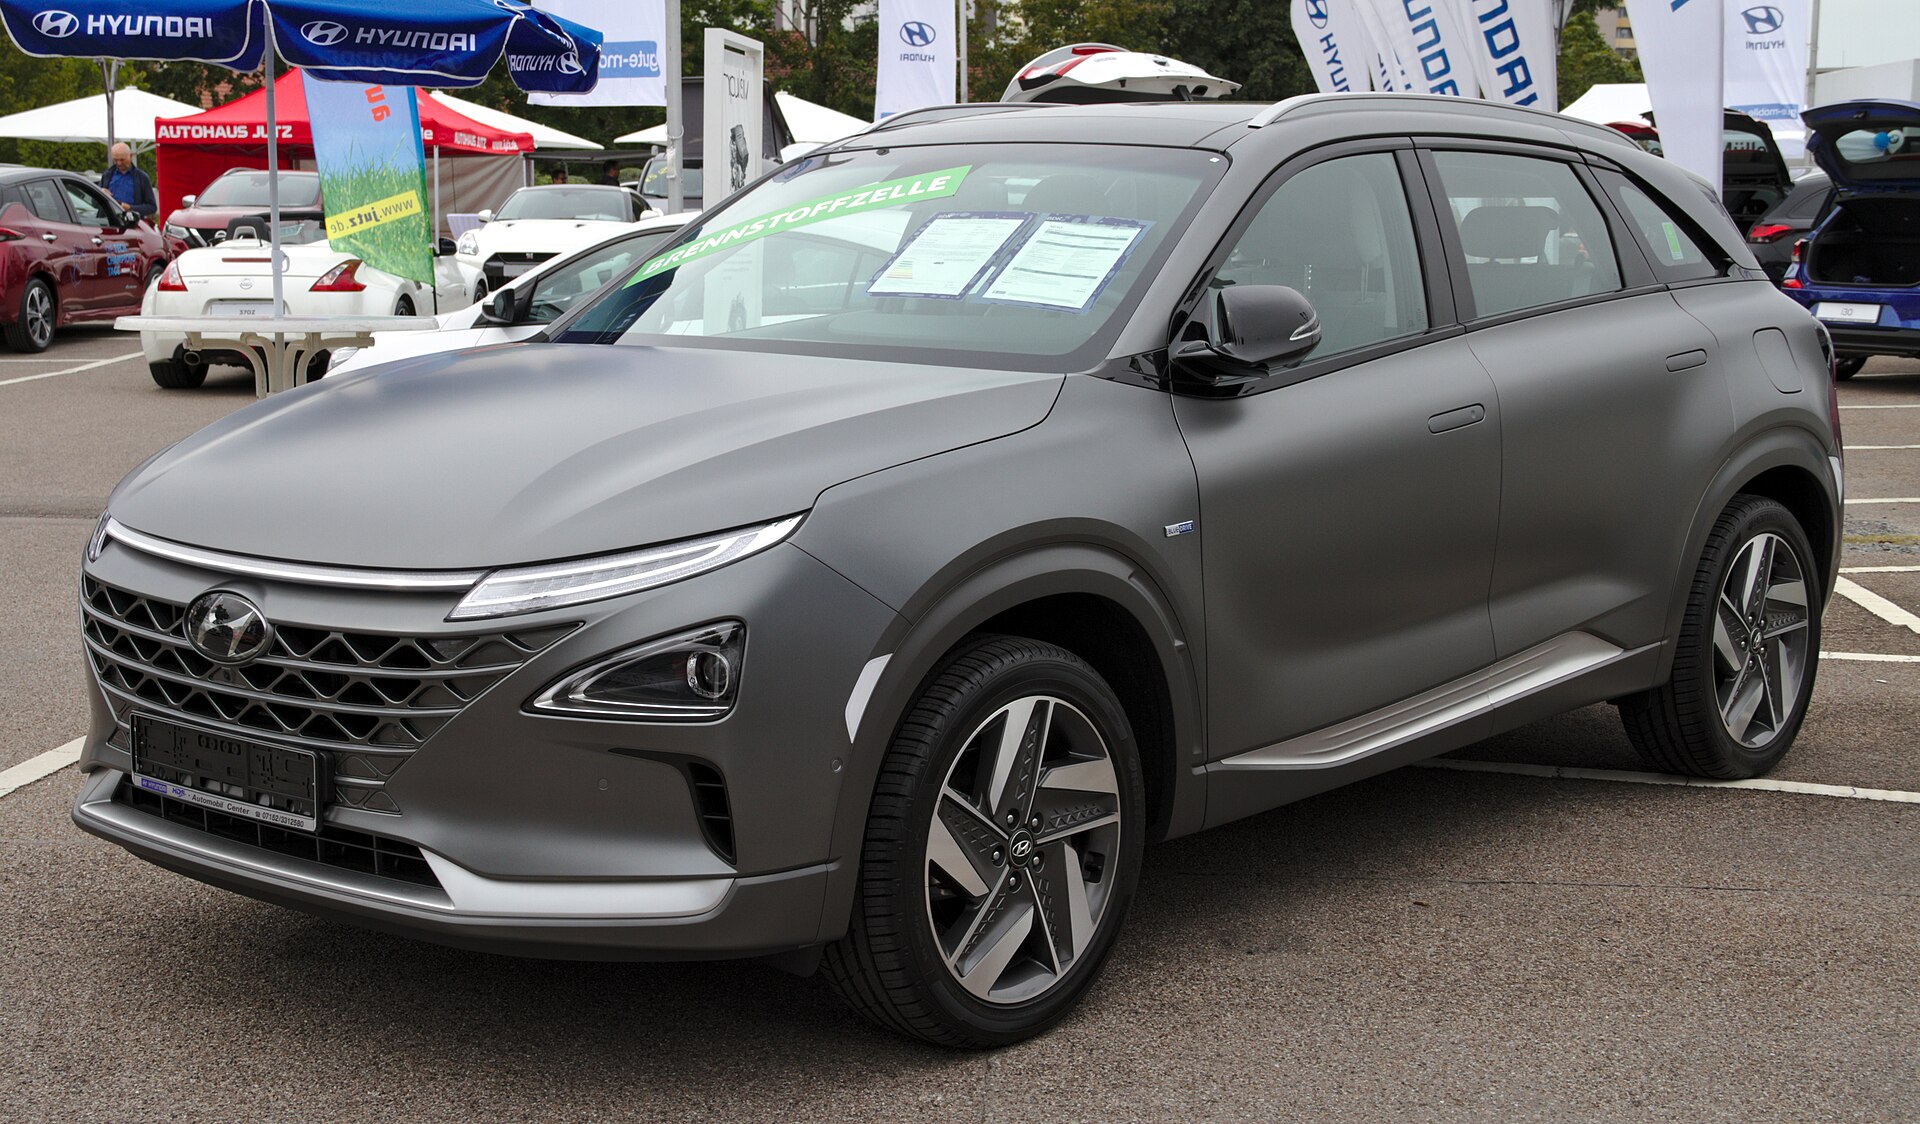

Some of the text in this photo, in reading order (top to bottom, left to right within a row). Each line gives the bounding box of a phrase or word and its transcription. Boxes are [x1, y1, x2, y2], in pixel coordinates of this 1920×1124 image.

[87, 14, 213, 38] HYUNDAI
[355, 27, 476, 51] HYUNDAI
[158, 125, 248, 139] AUTOHAUS
[642, 175, 951, 276] BRENNSTOFFZELLE
[191, 794, 224, 809] Automobil
[226, 803, 250, 815] Center
